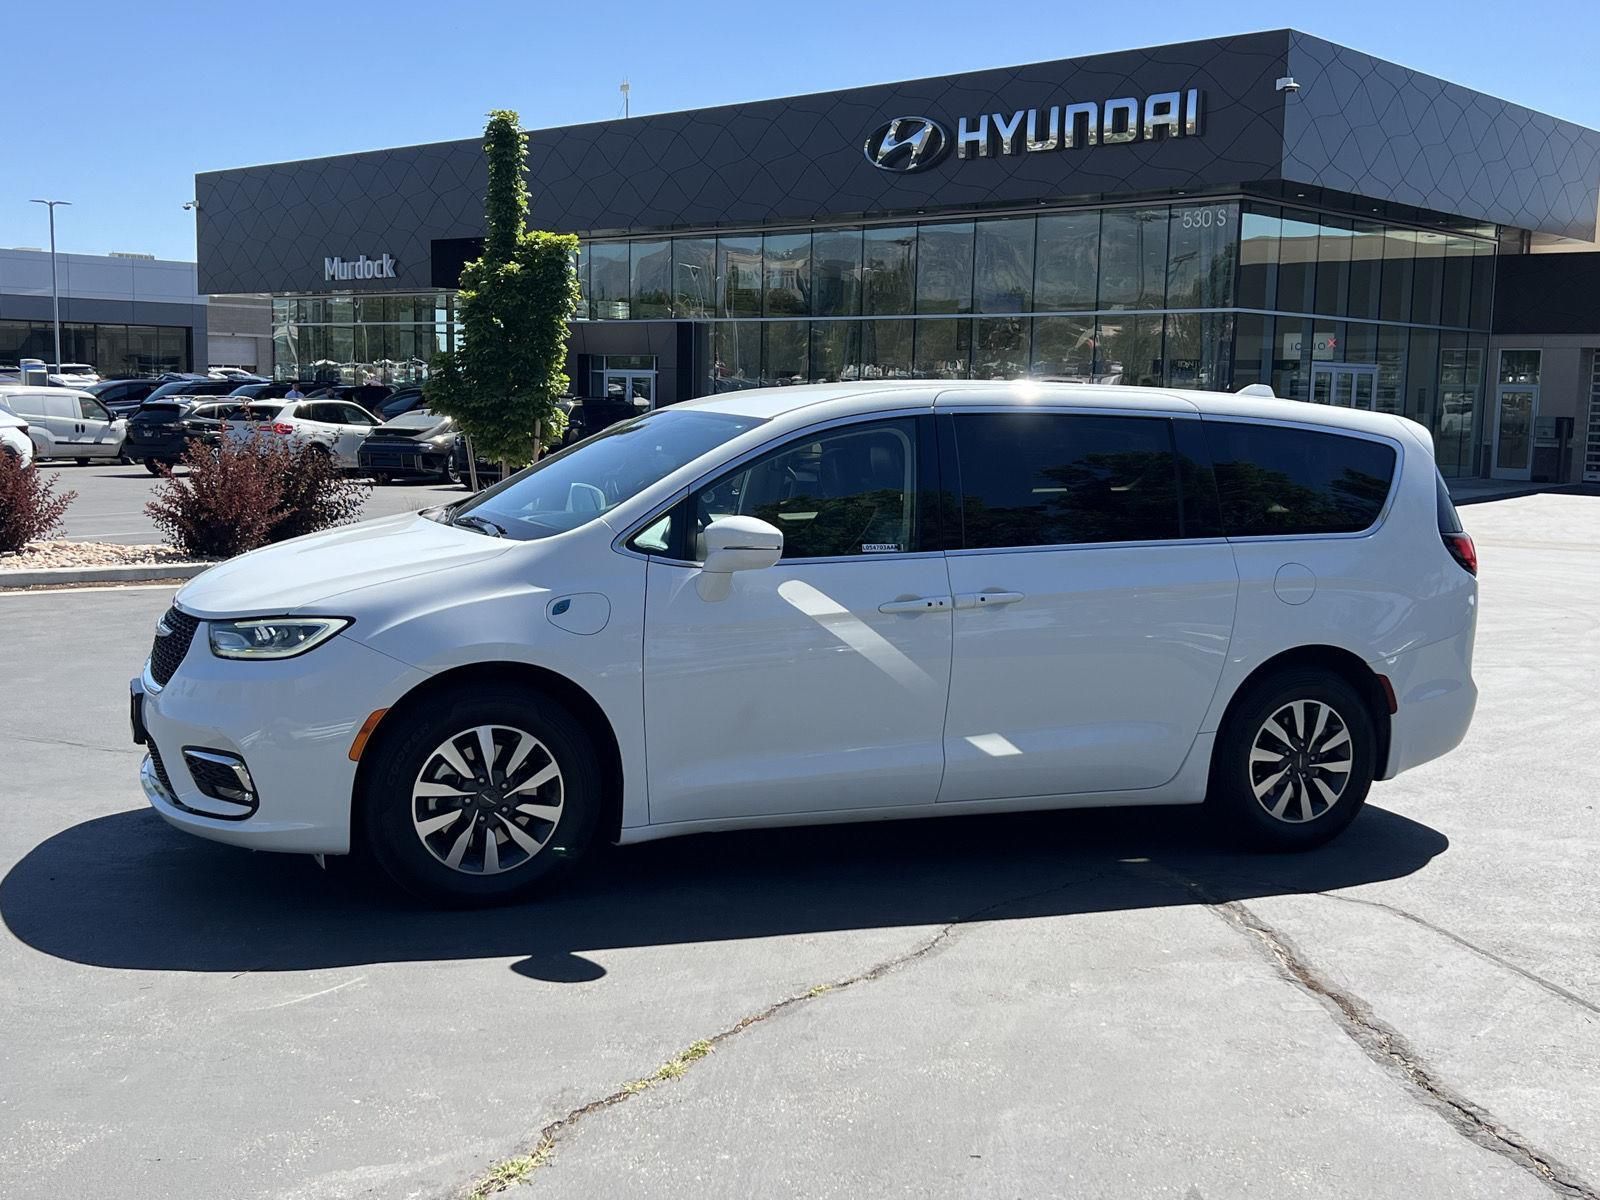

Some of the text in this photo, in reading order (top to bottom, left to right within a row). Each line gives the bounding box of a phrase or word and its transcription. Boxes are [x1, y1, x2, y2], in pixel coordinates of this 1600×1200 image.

[957, 88, 1198, 159] HYUNDAI
[1182, 209, 1227, 229] 530 S
[324, 253, 397, 281] Murdock
